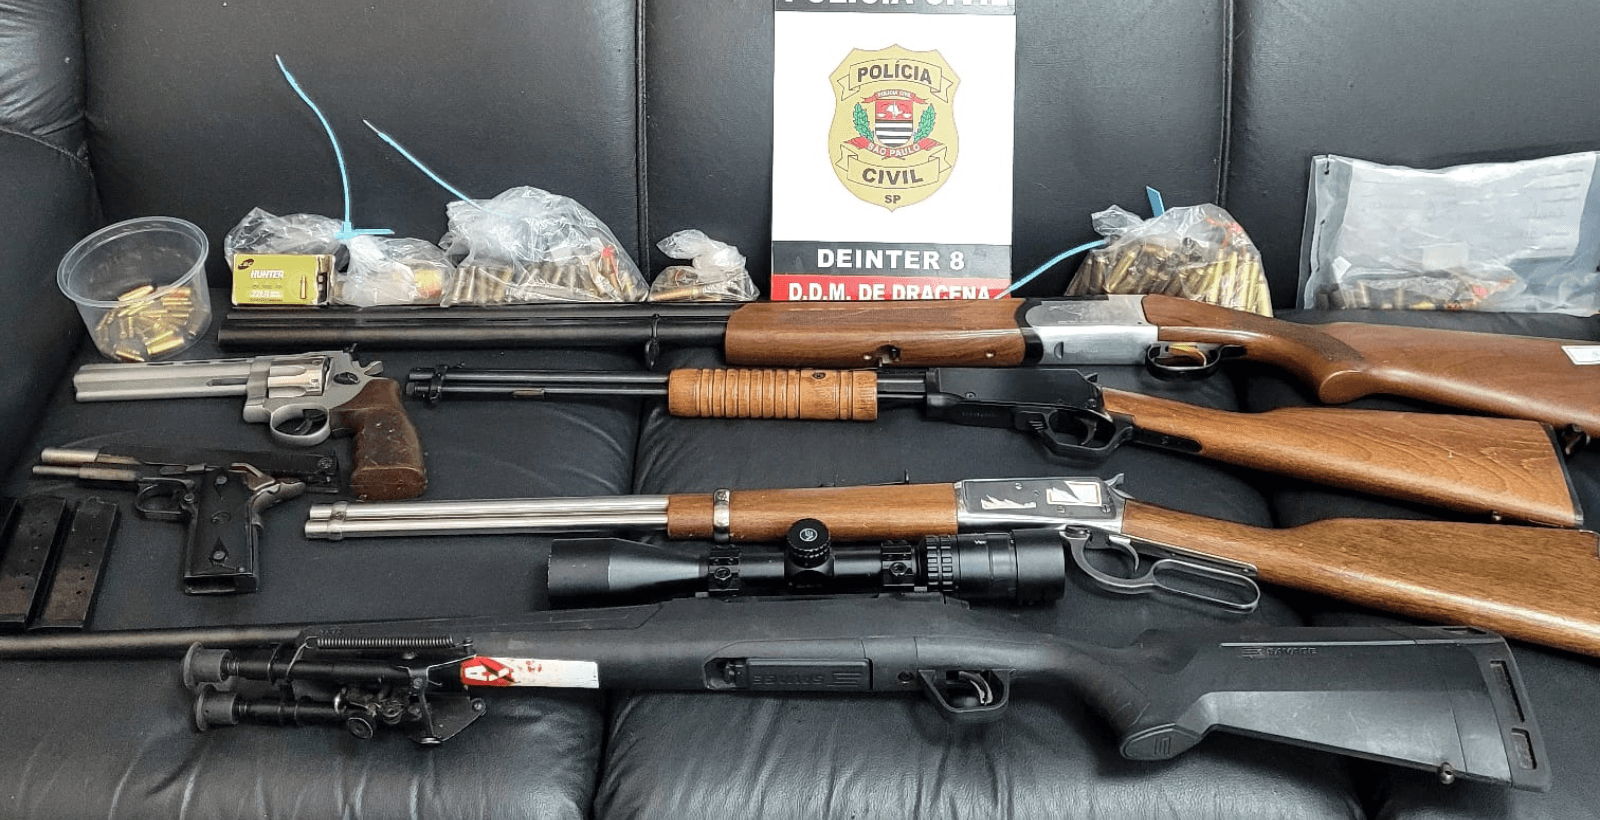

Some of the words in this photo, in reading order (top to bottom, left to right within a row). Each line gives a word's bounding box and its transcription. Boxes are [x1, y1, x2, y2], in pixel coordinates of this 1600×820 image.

[857, 60, 932, 85] POLÍCIA
[889, 143, 920, 157] PAULO
[861, 167, 924, 186] CIVIL
[884, 194, 901, 204] SP
[817, 249, 941, 270] DEINTER
[949, 251, 966, 271] 8
[250, 270, 284, 279] HUNTER
[788, 282, 851, 300] D.D.M.
[858, 283, 885, 300] DE
[892, 285, 990, 300] DRACENA
